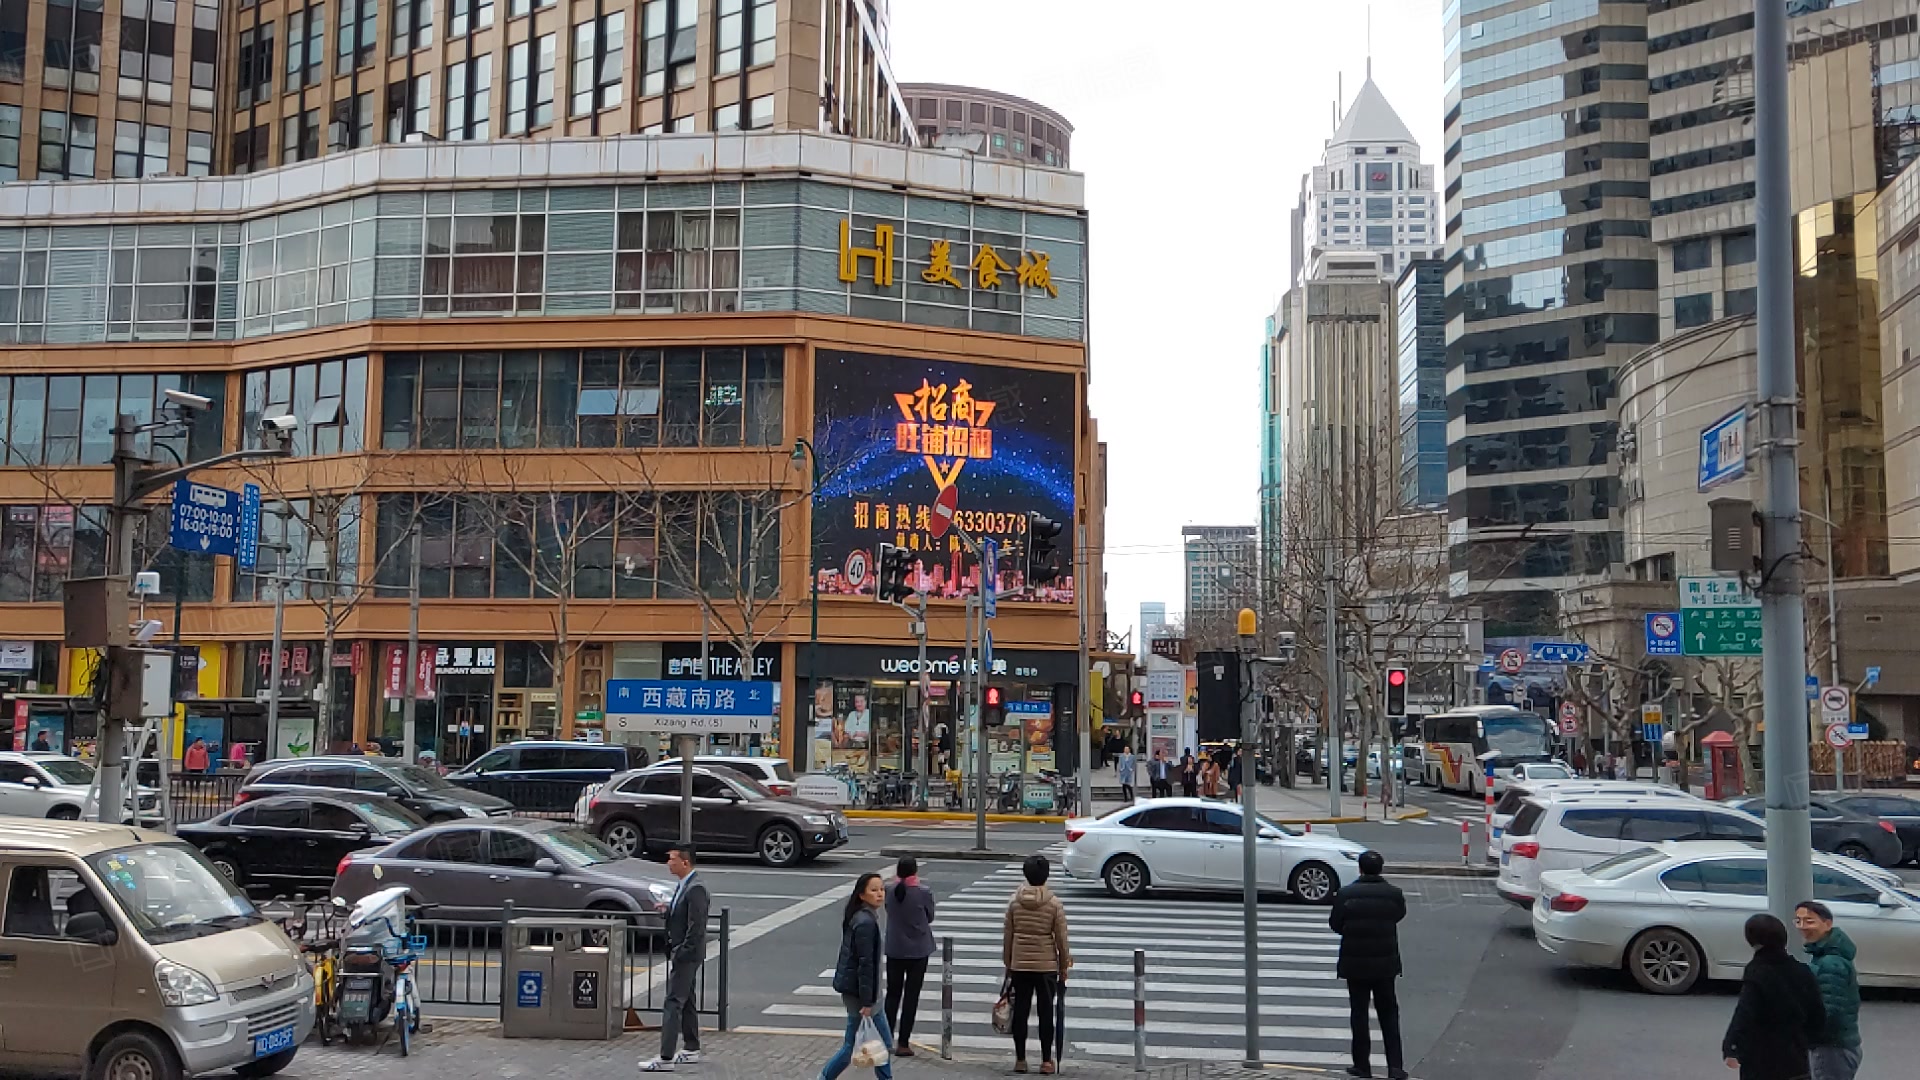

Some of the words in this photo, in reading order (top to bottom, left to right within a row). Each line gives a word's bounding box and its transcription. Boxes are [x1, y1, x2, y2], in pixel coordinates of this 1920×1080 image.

[921, 238, 1059, 298] 美食城
[912, 377, 977, 428] 招商
[895, 422, 993, 459] 旺铺招租
[180, 503, 234, 526] 07:00-10:00
[853, 500, 932, 532] 招商热线
[180, 518, 233, 538] 16:00-19:00
[850, 561, 863, 579] 40
[709, 657, 733, 676] THE
[733, 657, 774, 676] ALEY
[618, 686, 631, 699] 南
[641, 686, 737, 710] 西藏南路
[748, 689, 761, 701] 北
[618, 716, 628, 728] S
[654, 718, 687, 729] Xizang
[749, 718, 759, 729] N
